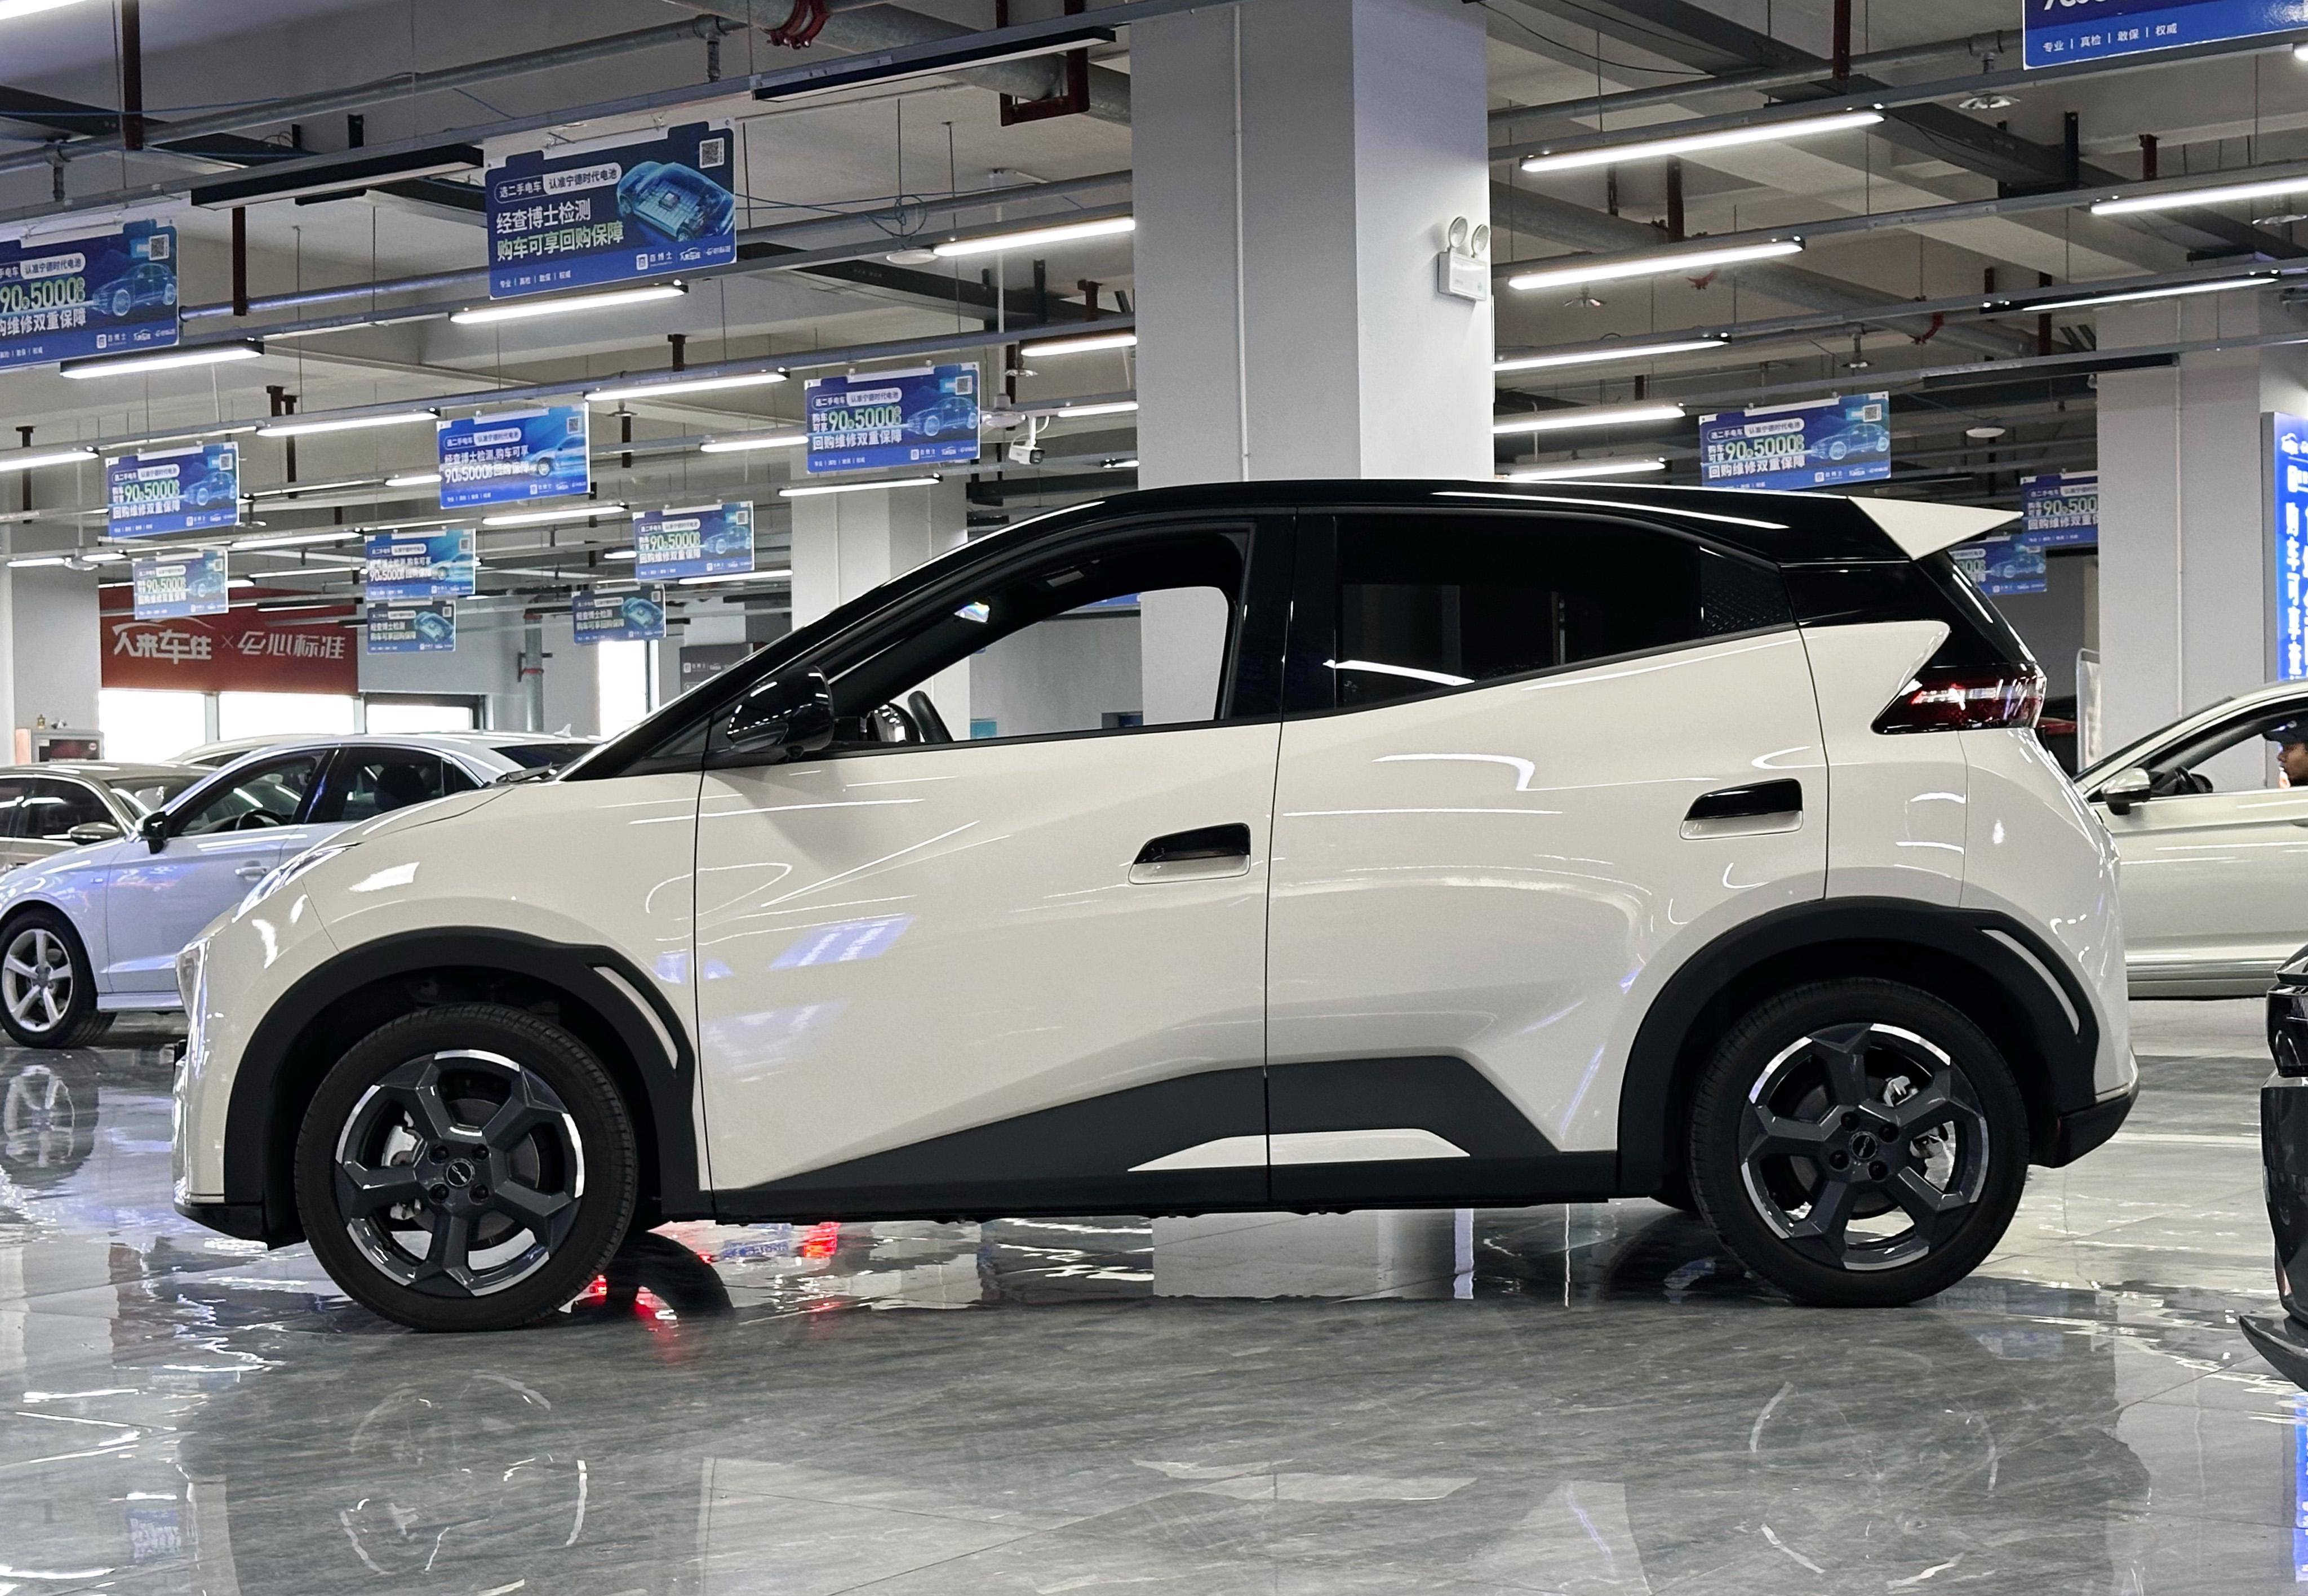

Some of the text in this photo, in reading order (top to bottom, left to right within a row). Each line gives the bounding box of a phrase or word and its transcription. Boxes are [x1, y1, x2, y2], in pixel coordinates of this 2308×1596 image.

[2043, 23, 2177, 52] 专业 真检 敢保 权威
[499, 168, 617, 198] 选二手电车 认准宁德时代电池
[496, 198, 591, 234] 经查博士检测
[497, 220, 624, 262] 购车可享回购保障
[25, 257, 82, 275] 认准宁德时代电池
[813, 429, 902, 451] 回购维修双重保障
[1709, 455, 1805, 479] 回购维修双重保障
